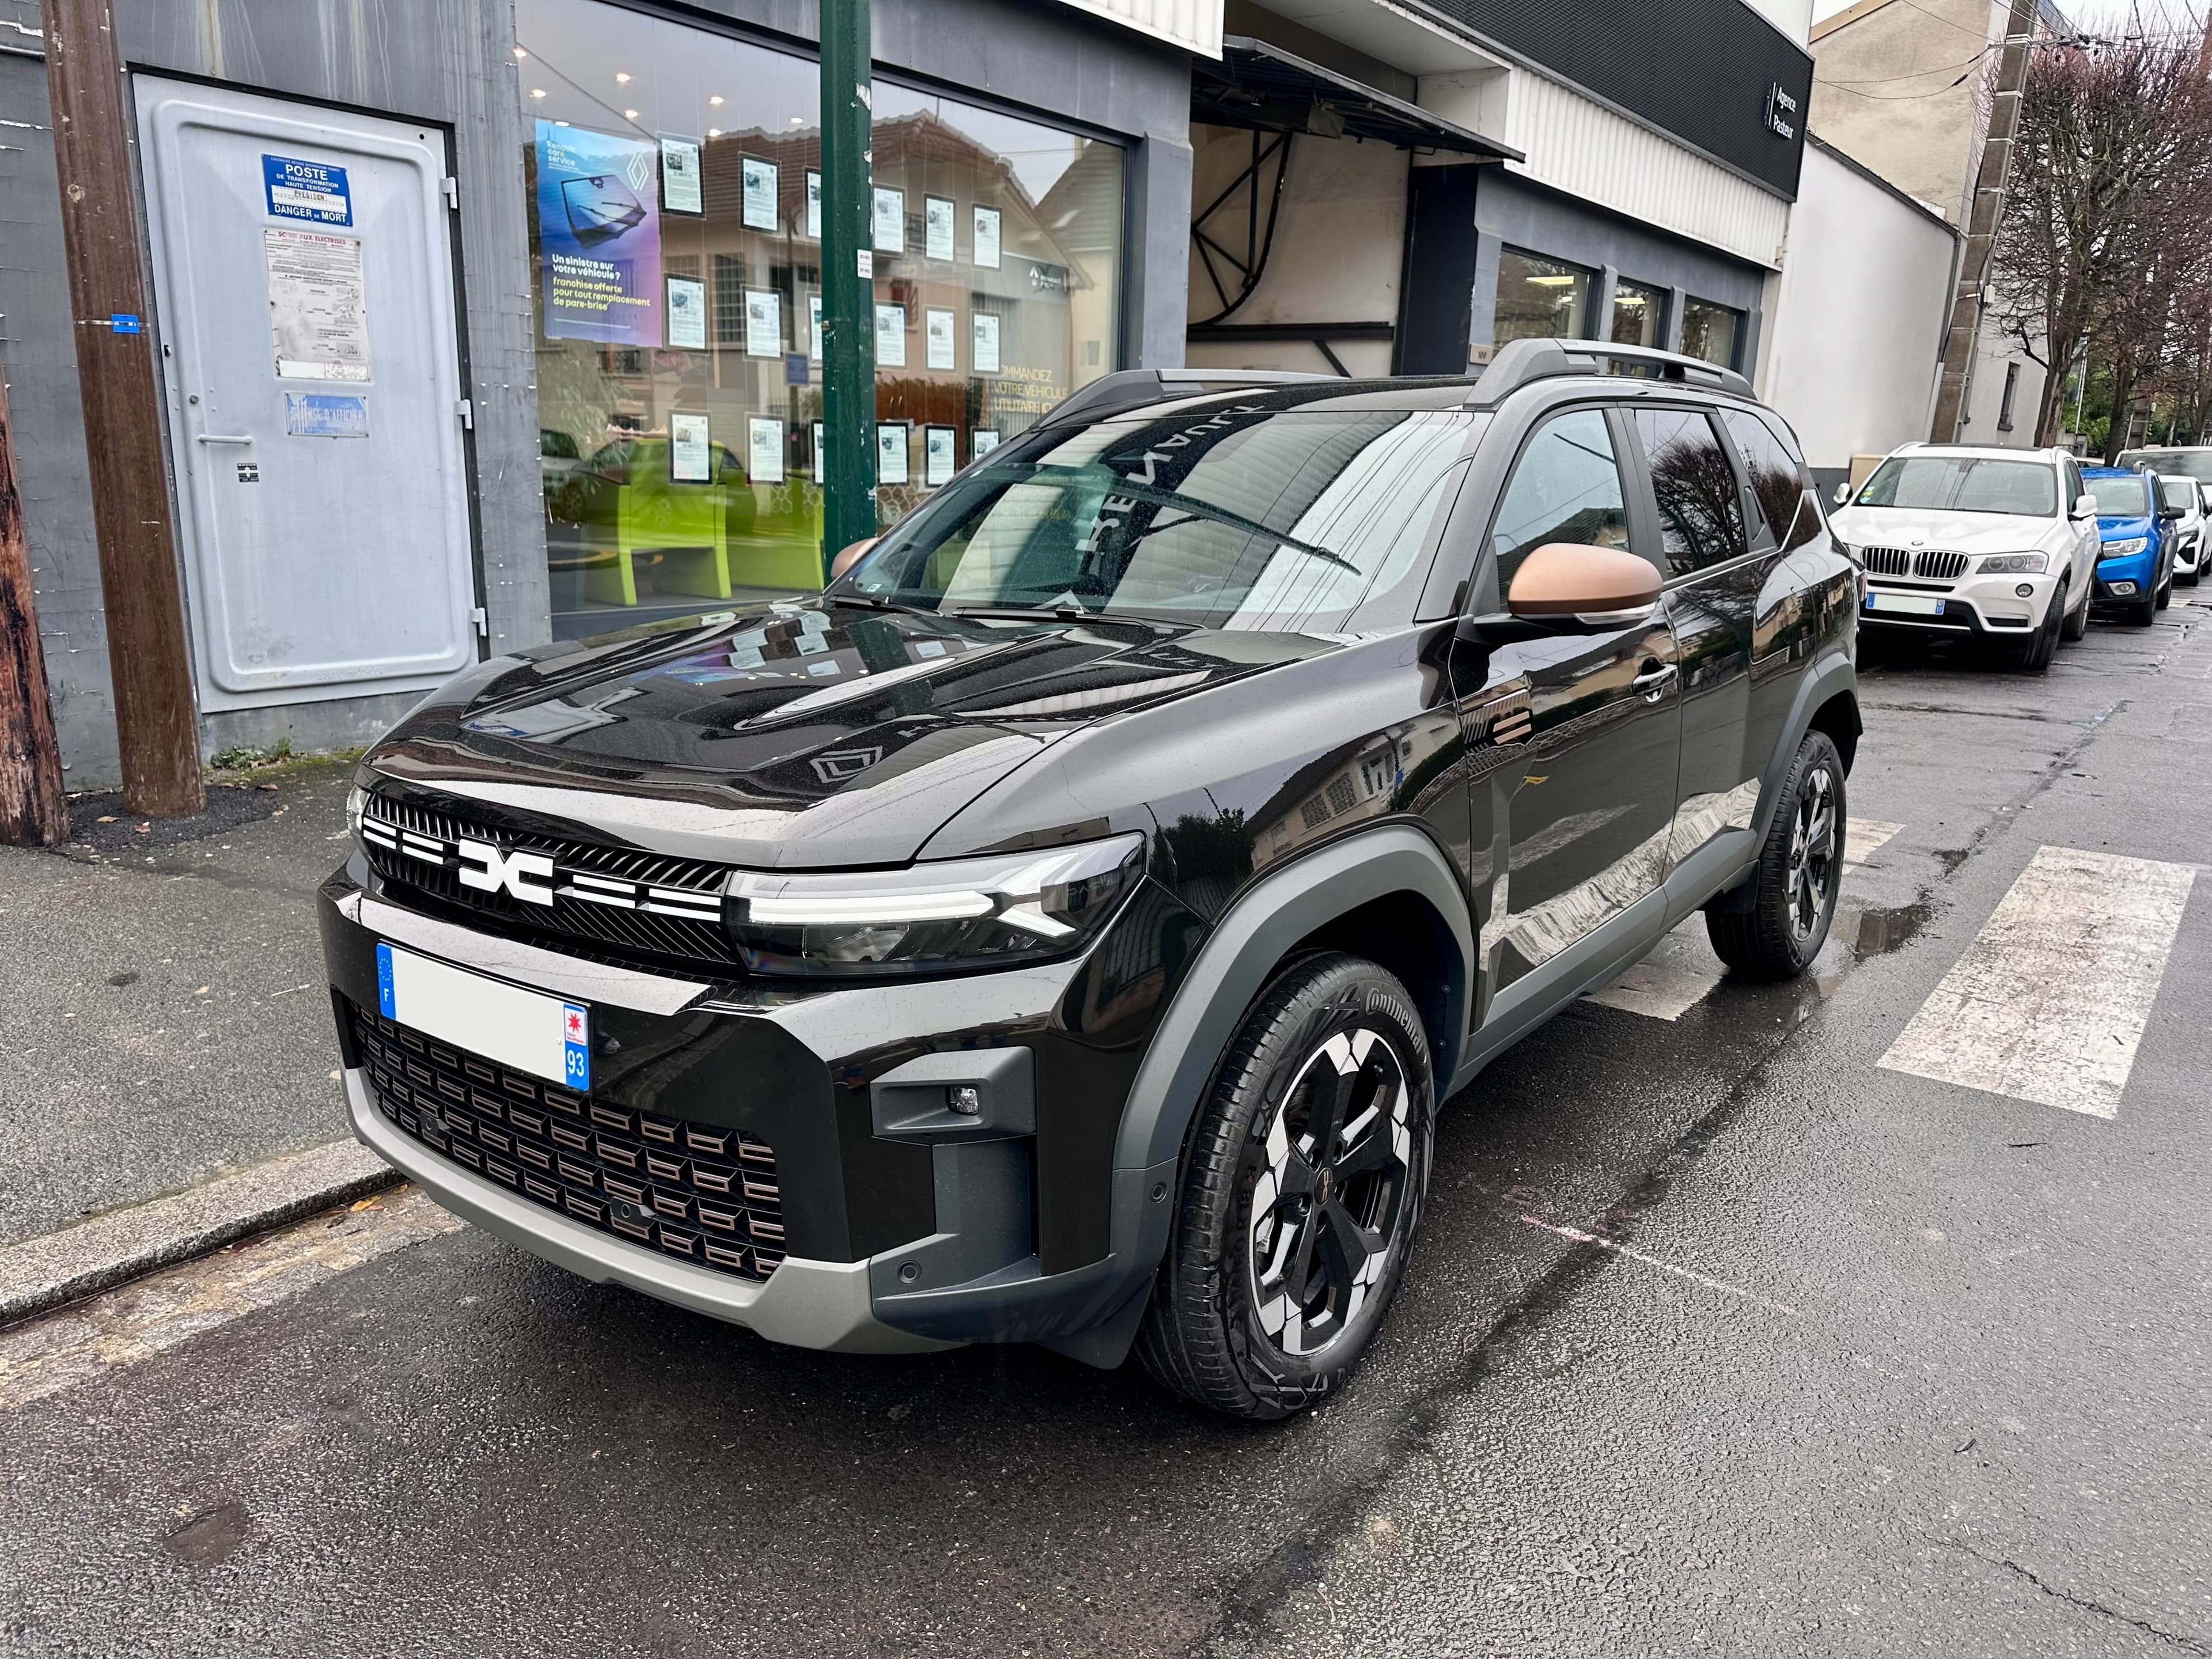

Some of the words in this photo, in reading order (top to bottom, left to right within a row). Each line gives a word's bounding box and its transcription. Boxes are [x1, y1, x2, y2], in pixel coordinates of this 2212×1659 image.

[1777, 86, 1796, 112] Agence
[1774, 114, 1793, 139] Pasteur
[547, 141, 575, 153] Renault
[548, 149, 564, 157] care
[548, 156, 575, 166] service
[286, 164, 328, 180] POSTE
[287, 175, 339, 188] TRANSFORMATION
[306, 184, 332, 193] TENSION
[294, 190, 327, 201] PRESIDEN
[274, 204, 312, 218] DANGER
[321, 211, 346, 222] MORT
[552, 253, 564, 264] Un
[565, 256, 599, 269] sinistre
[600, 262, 614, 271] sur
[552, 264, 576, 275] votre
[553, 276, 593, 290] franchise
[594, 282, 622, 293] offerte
[553, 288, 573, 297] pour
[574, 290, 592, 299] tout
[593, 293, 650, 307] remplacement
[554, 298, 564, 306] de
[1001, 364, 1052, 382] OMMANDEZ
[993, 381, 1024, 396] VOTRE
[1024, 382, 1068, 399] VÉHICULE
[994, 397, 1040, 414] UTILITAIRE
[325, 408, 363, 424] D'AFFICHER
[384, 987, 389, 1002] F
[1366, 987, 1424, 1055] Continental
[567, 1050, 585, 1077] 93
